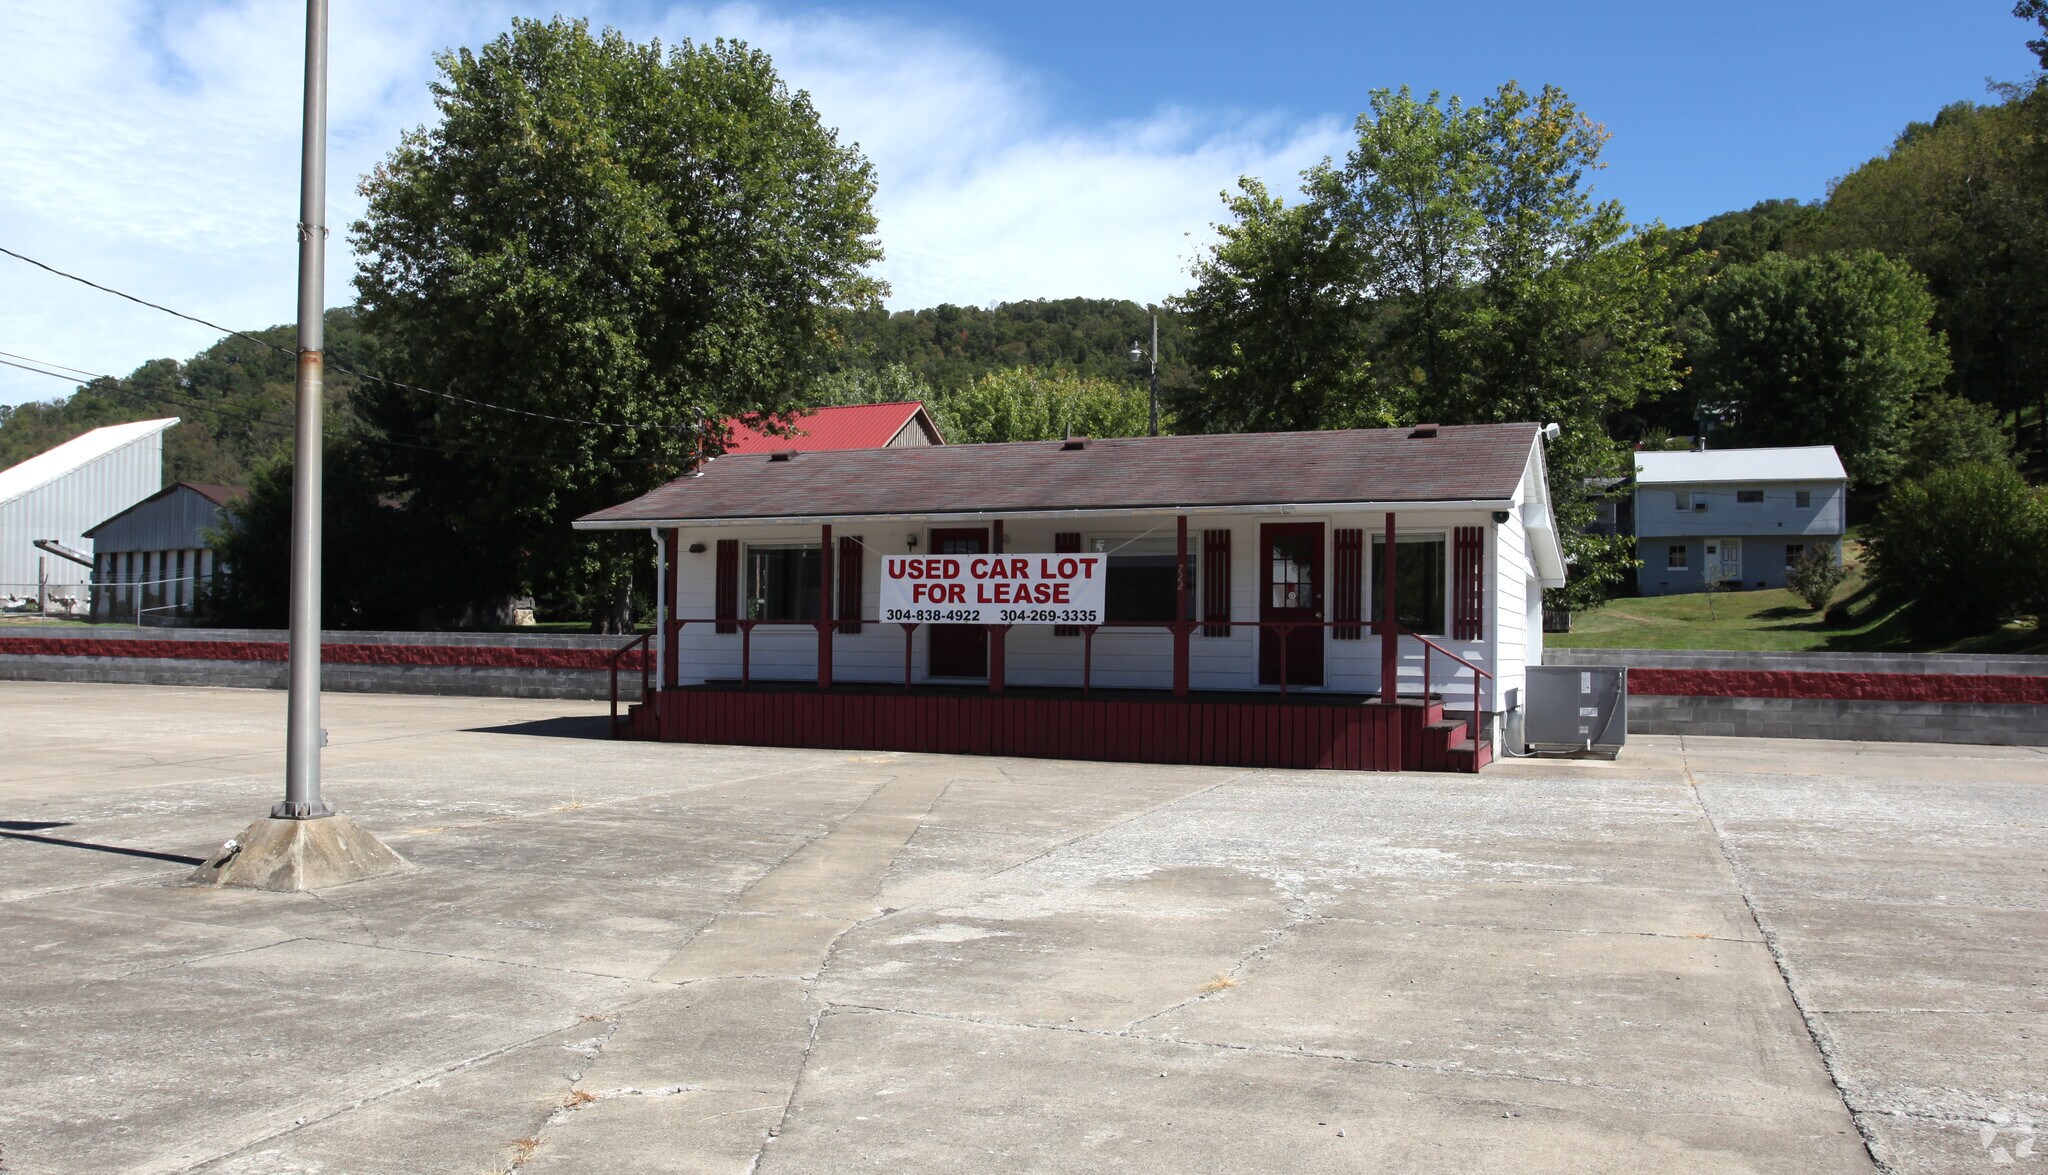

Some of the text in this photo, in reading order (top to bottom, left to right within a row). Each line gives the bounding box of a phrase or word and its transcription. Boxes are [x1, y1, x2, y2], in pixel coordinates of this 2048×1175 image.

[888, 558, 1098, 580] USED CAR LOT
[912, 583, 1071, 604] FOR LEASE
[886, 609, 1097, 622] 304-838-4922 304-269-3335
